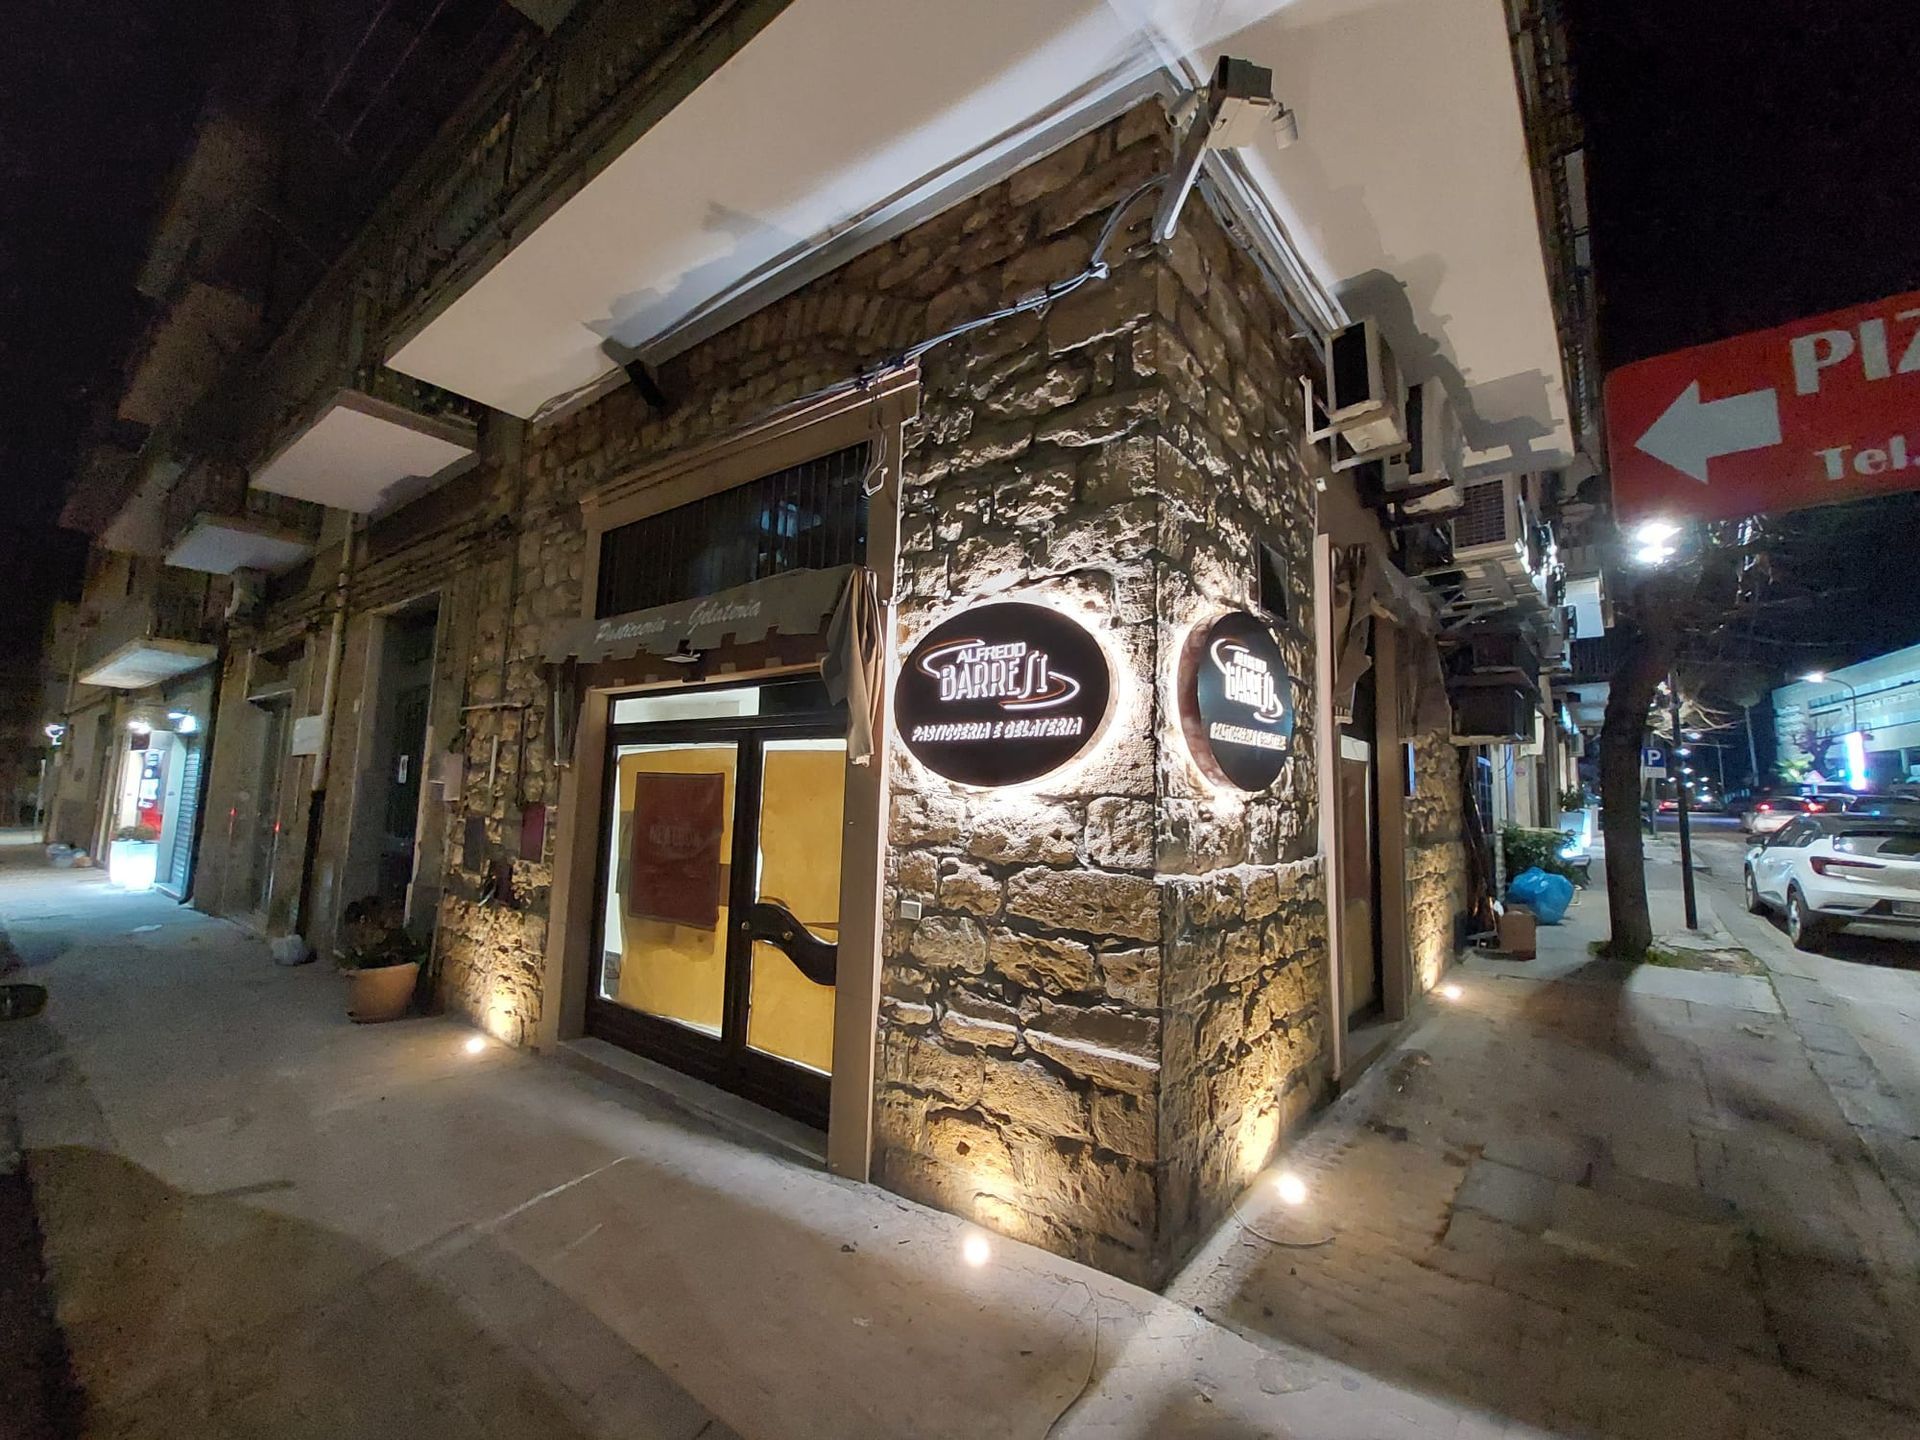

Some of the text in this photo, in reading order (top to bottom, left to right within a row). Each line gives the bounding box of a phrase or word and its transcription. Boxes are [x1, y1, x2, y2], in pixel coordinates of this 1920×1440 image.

[956, 641, 1027, 664] ALFREDO
[939, 650, 1049, 701] BARRESI
[912, 721, 992, 743] PASTICCERIA
[1004, 716, 1083, 739] GELATERIA
[1647, 749, 1661, 766] P
